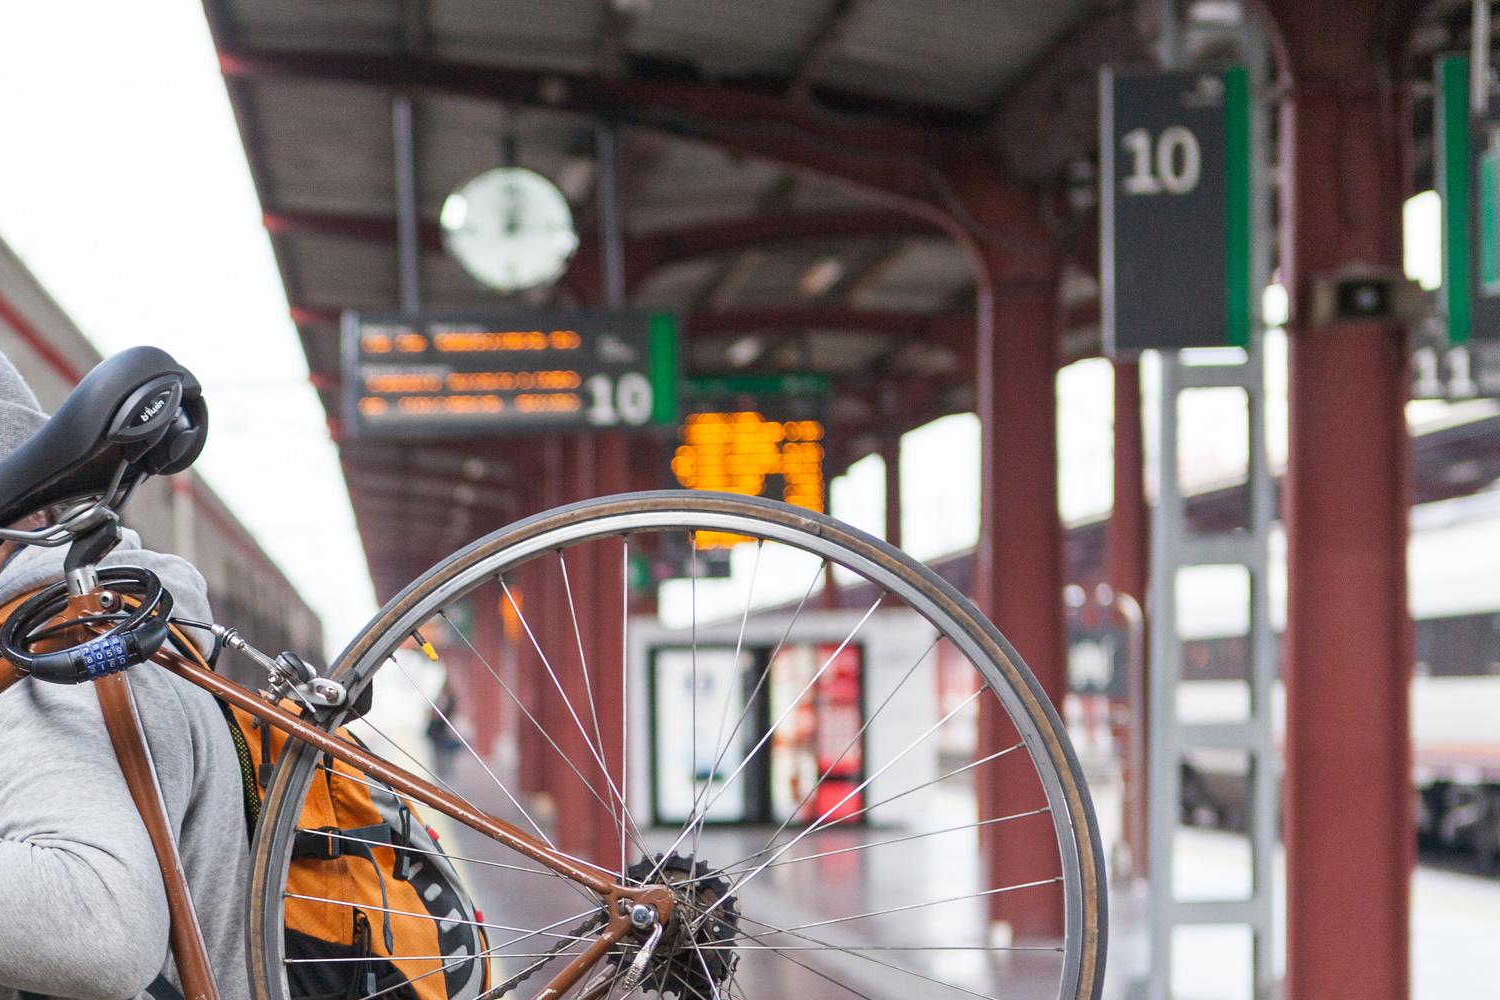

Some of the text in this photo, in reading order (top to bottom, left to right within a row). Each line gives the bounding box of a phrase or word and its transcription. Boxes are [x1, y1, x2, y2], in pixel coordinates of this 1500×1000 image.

[1122, 126, 1201, 194] 10
[584, 372, 654, 426] 10
[1412, 346, 1476, 398] 11
